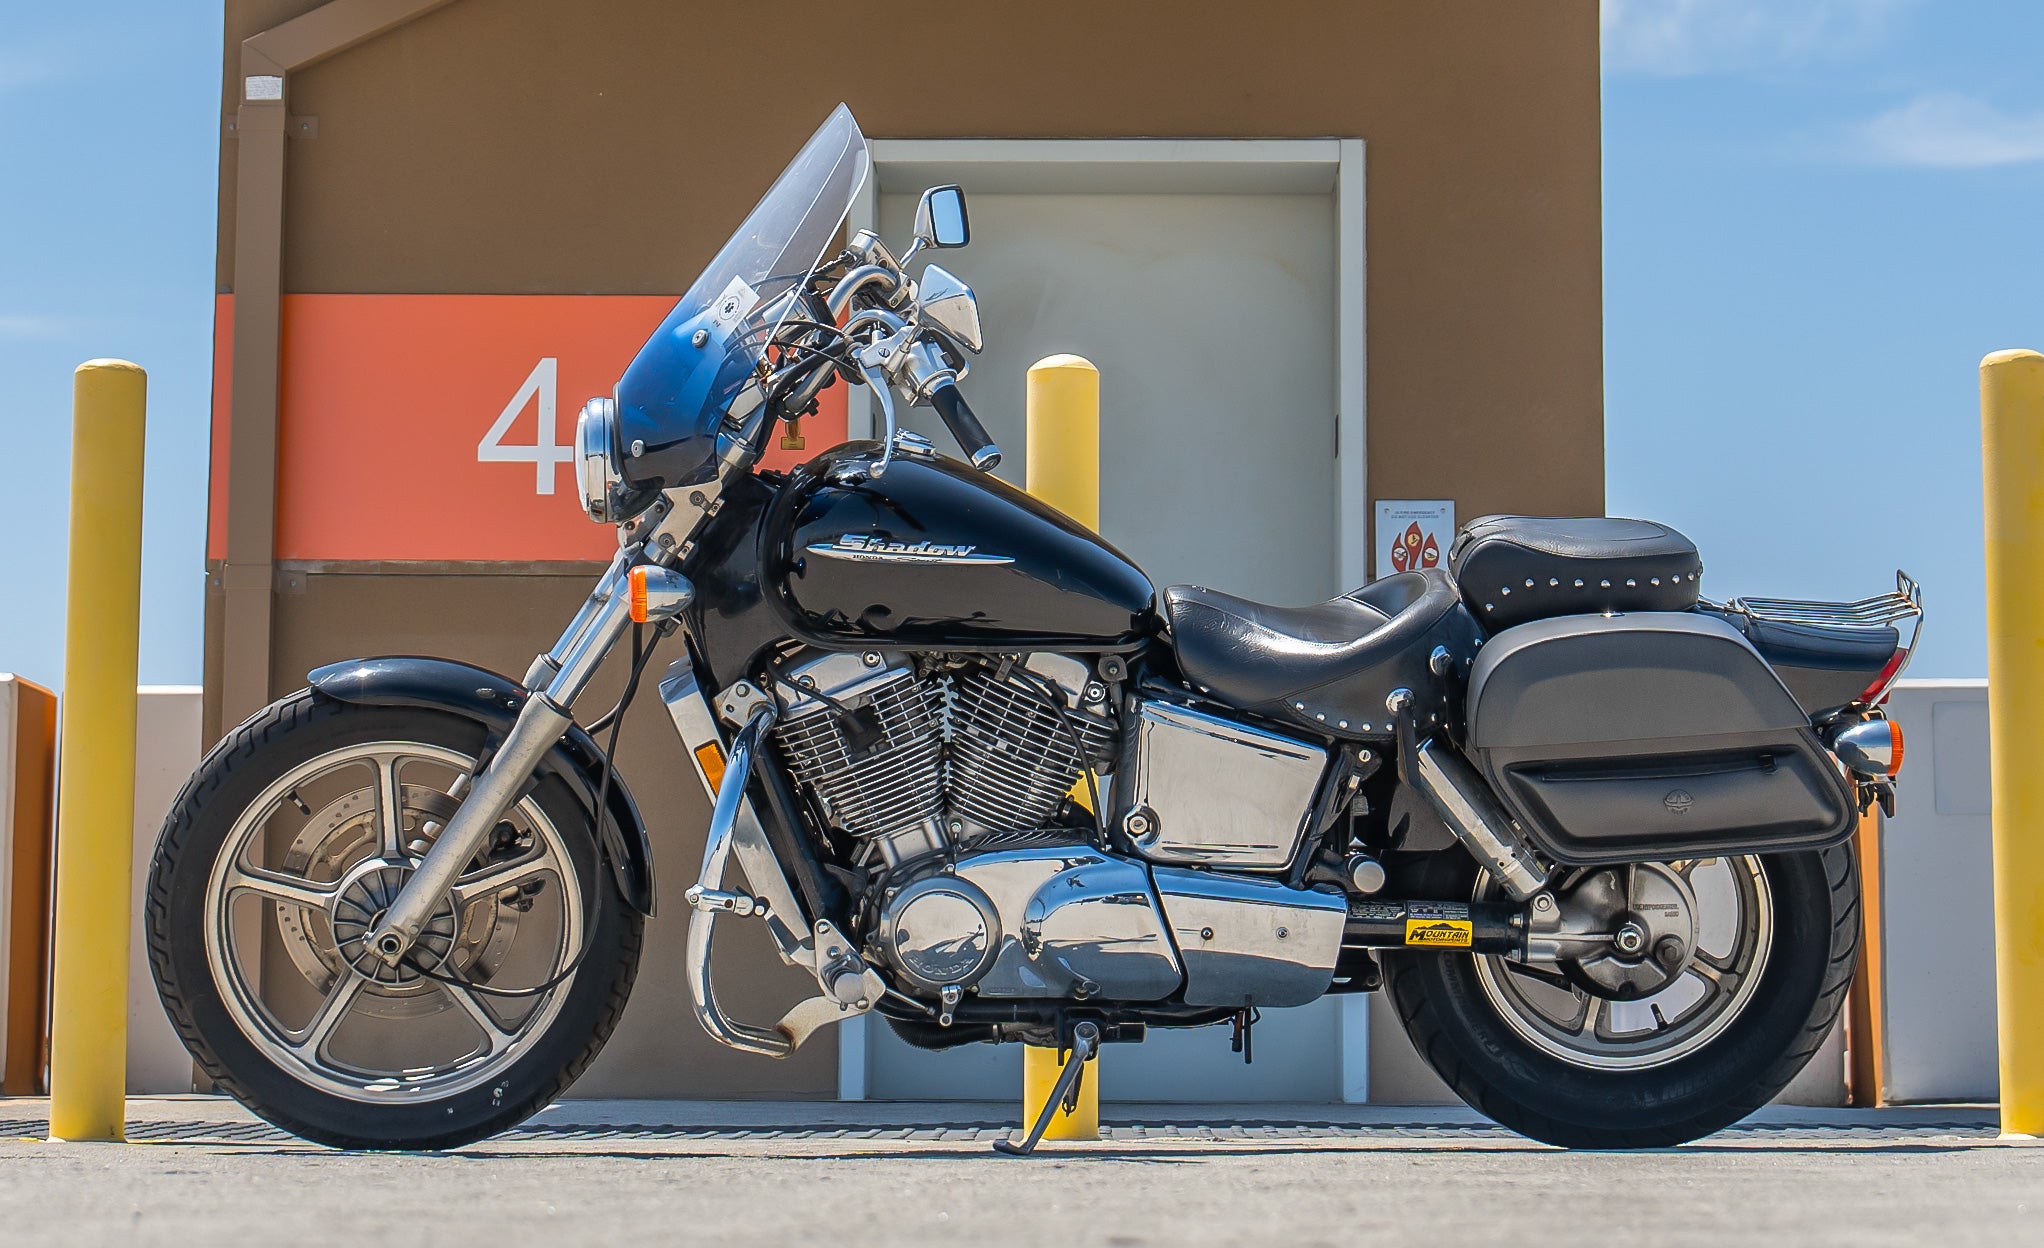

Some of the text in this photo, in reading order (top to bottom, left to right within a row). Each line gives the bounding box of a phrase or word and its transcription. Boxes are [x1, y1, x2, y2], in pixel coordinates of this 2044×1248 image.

[477, 357, 574, 495] 4
[832, 533, 977, 557] Shadow
[1408, 929, 1470, 941] MOUNTAIN
